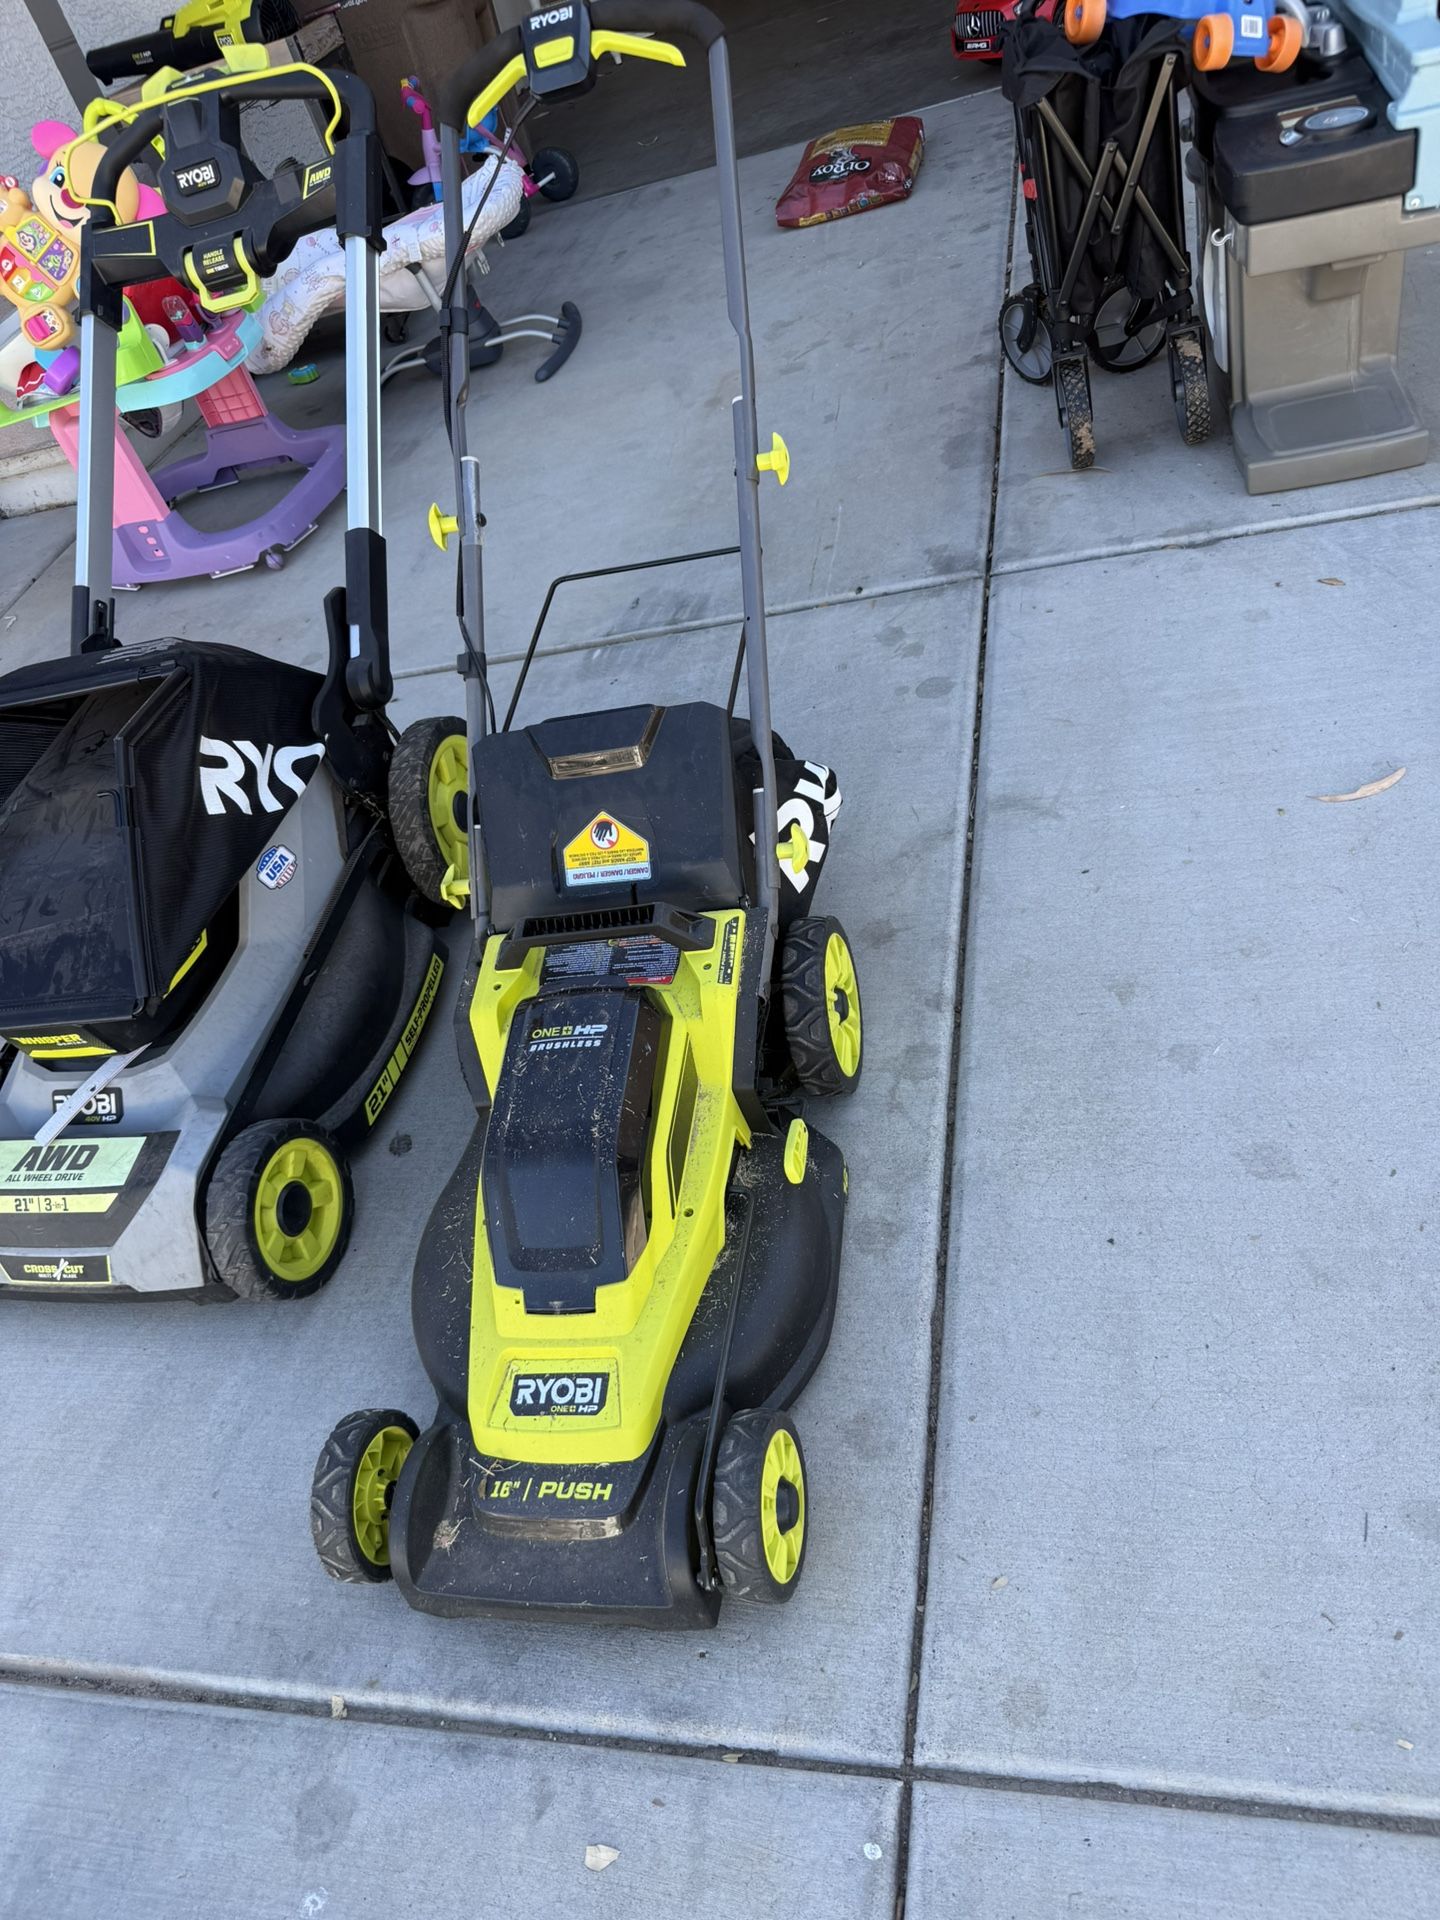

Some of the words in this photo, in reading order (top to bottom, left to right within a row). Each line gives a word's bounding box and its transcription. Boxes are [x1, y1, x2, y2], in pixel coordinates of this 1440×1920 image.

[529, 5, 574, 31] RYOBI
[176, 163, 216, 189] RYOBI
[309, 166, 332, 185] AWD
[265, 853, 290, 881] USA
[404, 958, 441, 1046] SELF-PROPELLED
[10, 1033, 82, 1046] WHISPER
[528, 1039, 602, 1052] BRUSHLESS
[368, 1073, 389, 1116] 21"
[11, 1144, 100, 1172] AWD
[5, 1174, 21, 1183] ALL
[23, 1173, 53, 1182] WHEEL
[55, 1173, 85, 1181] DRIVE
[14, 1197, 34, 1212] 21"
[63, 1265, 84, 1274] CUT
[516, 1377, 603, 1405] RYOBI
[578, 1405, 599, 1413] HP
[490, 1480, 521, 1498] 16"
[537, 1481, 614, 1501] PUSH
